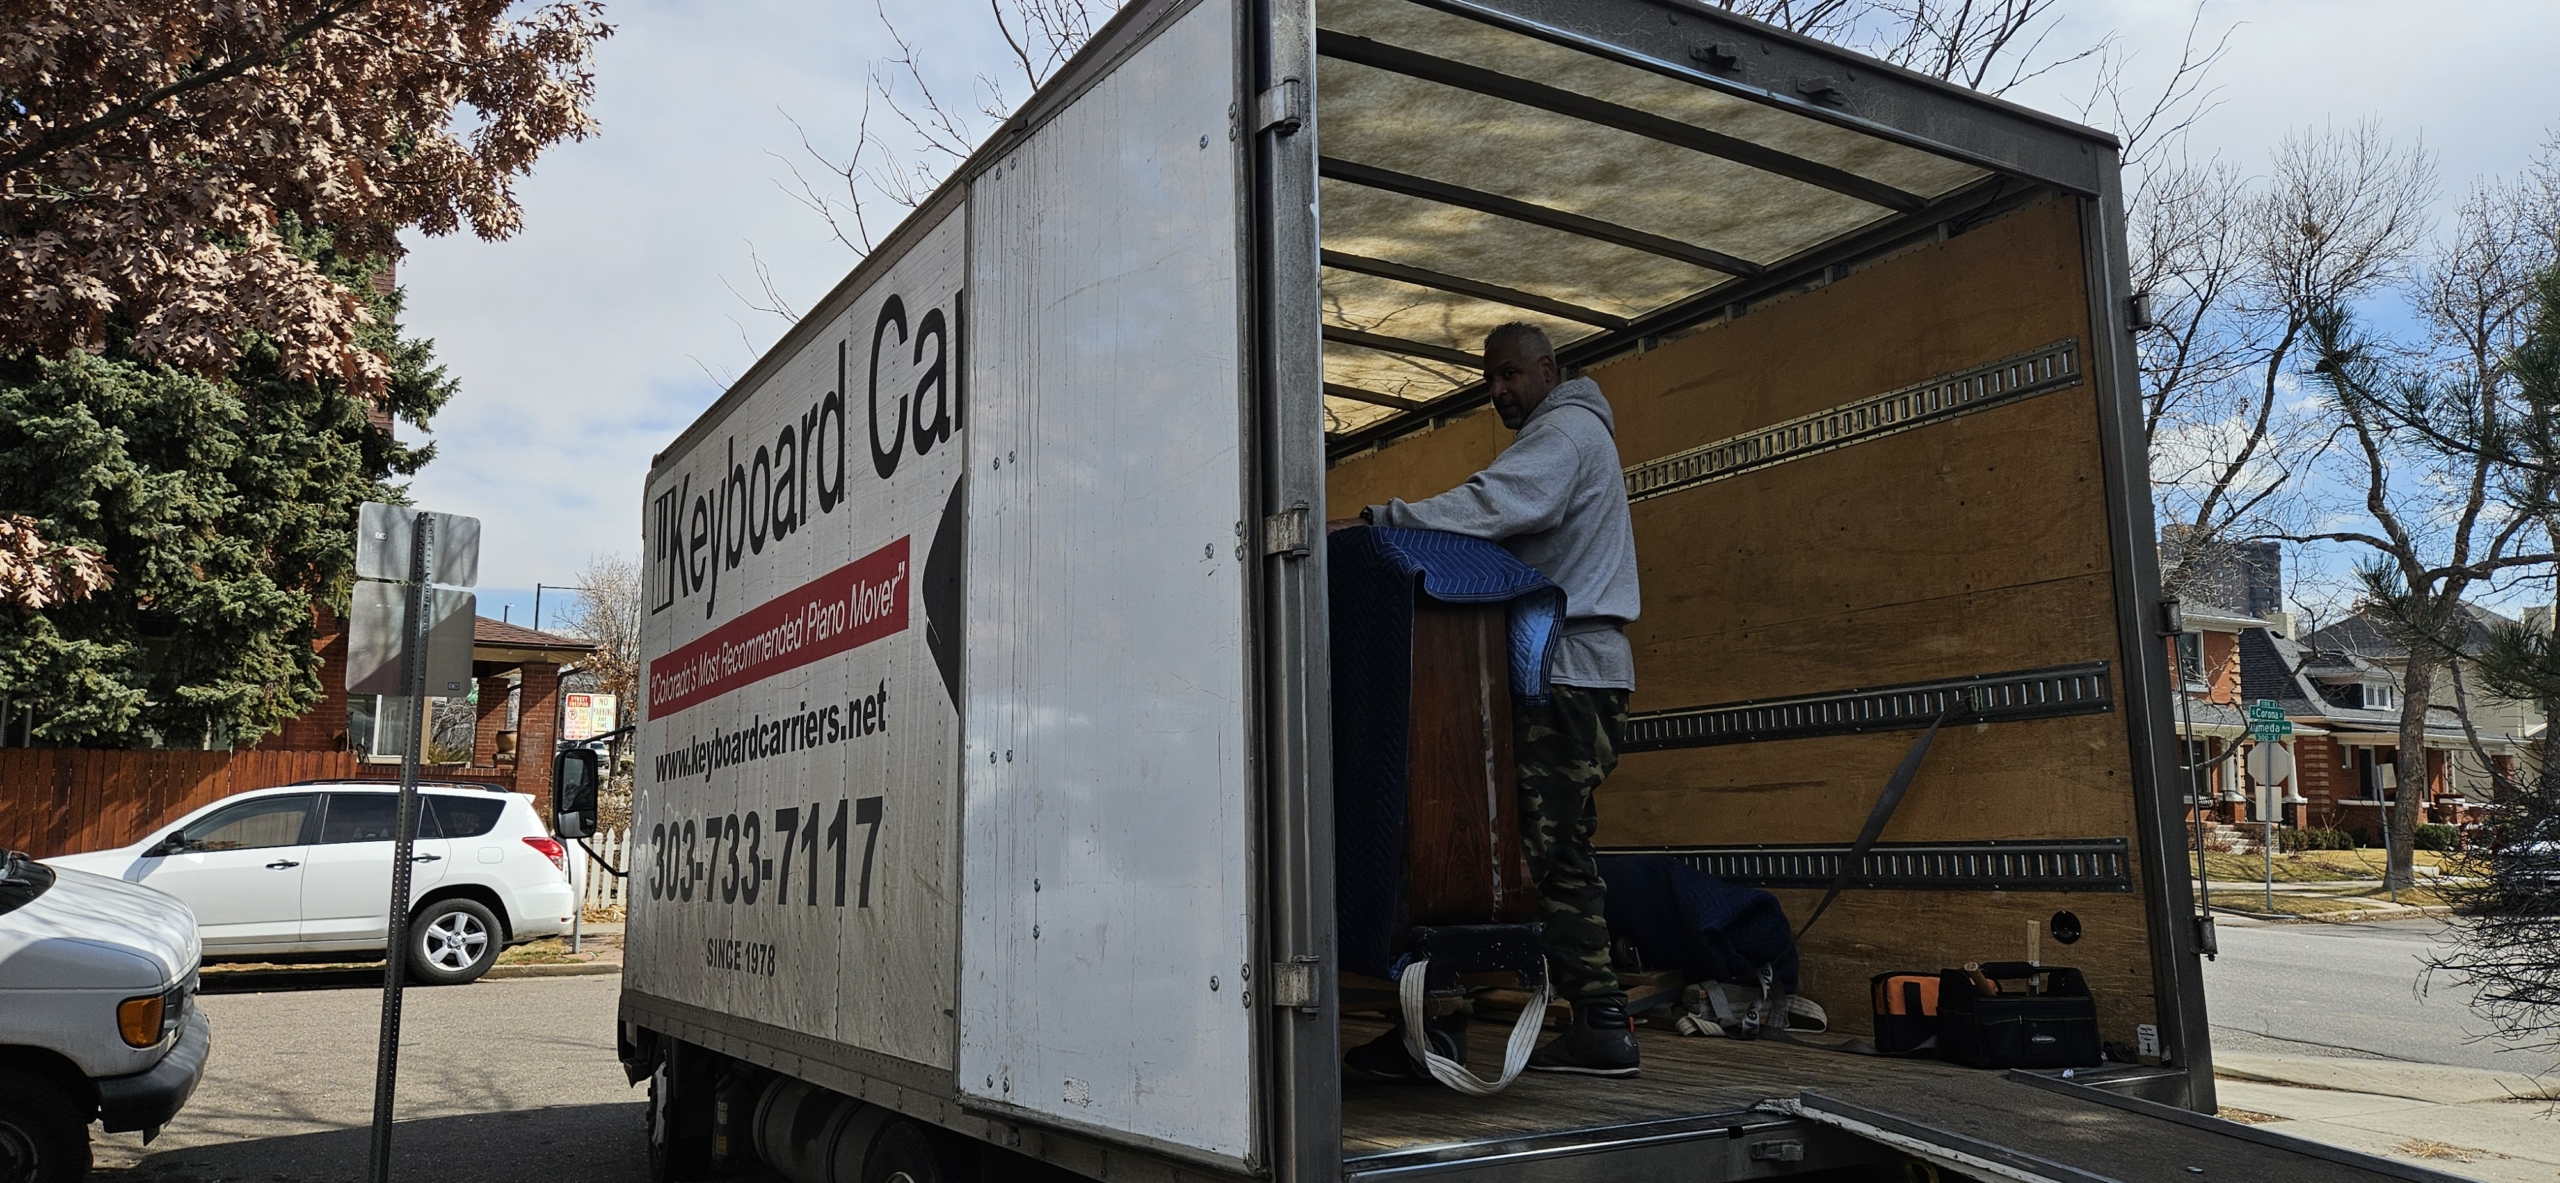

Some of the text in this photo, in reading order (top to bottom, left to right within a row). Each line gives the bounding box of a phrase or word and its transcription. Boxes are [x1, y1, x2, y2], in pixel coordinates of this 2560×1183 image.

[669, 338, 846, 620] Keyboard
[650, 560, 906, 706] "Colorado's Most Recommended Piano Mover"
[593, 708, 613, 717] PARKING
[599, 697, 609, 706] NO
[2256, 708, 2279, 719] Corona
[655, 676, 887, 783] www.keyboardcarriers.net
[2250, 723, 2280, 733] Alameda
[650, 795, 884, 908] 303-733-7117
[706, 937, 776, 977] SINCE 1978
